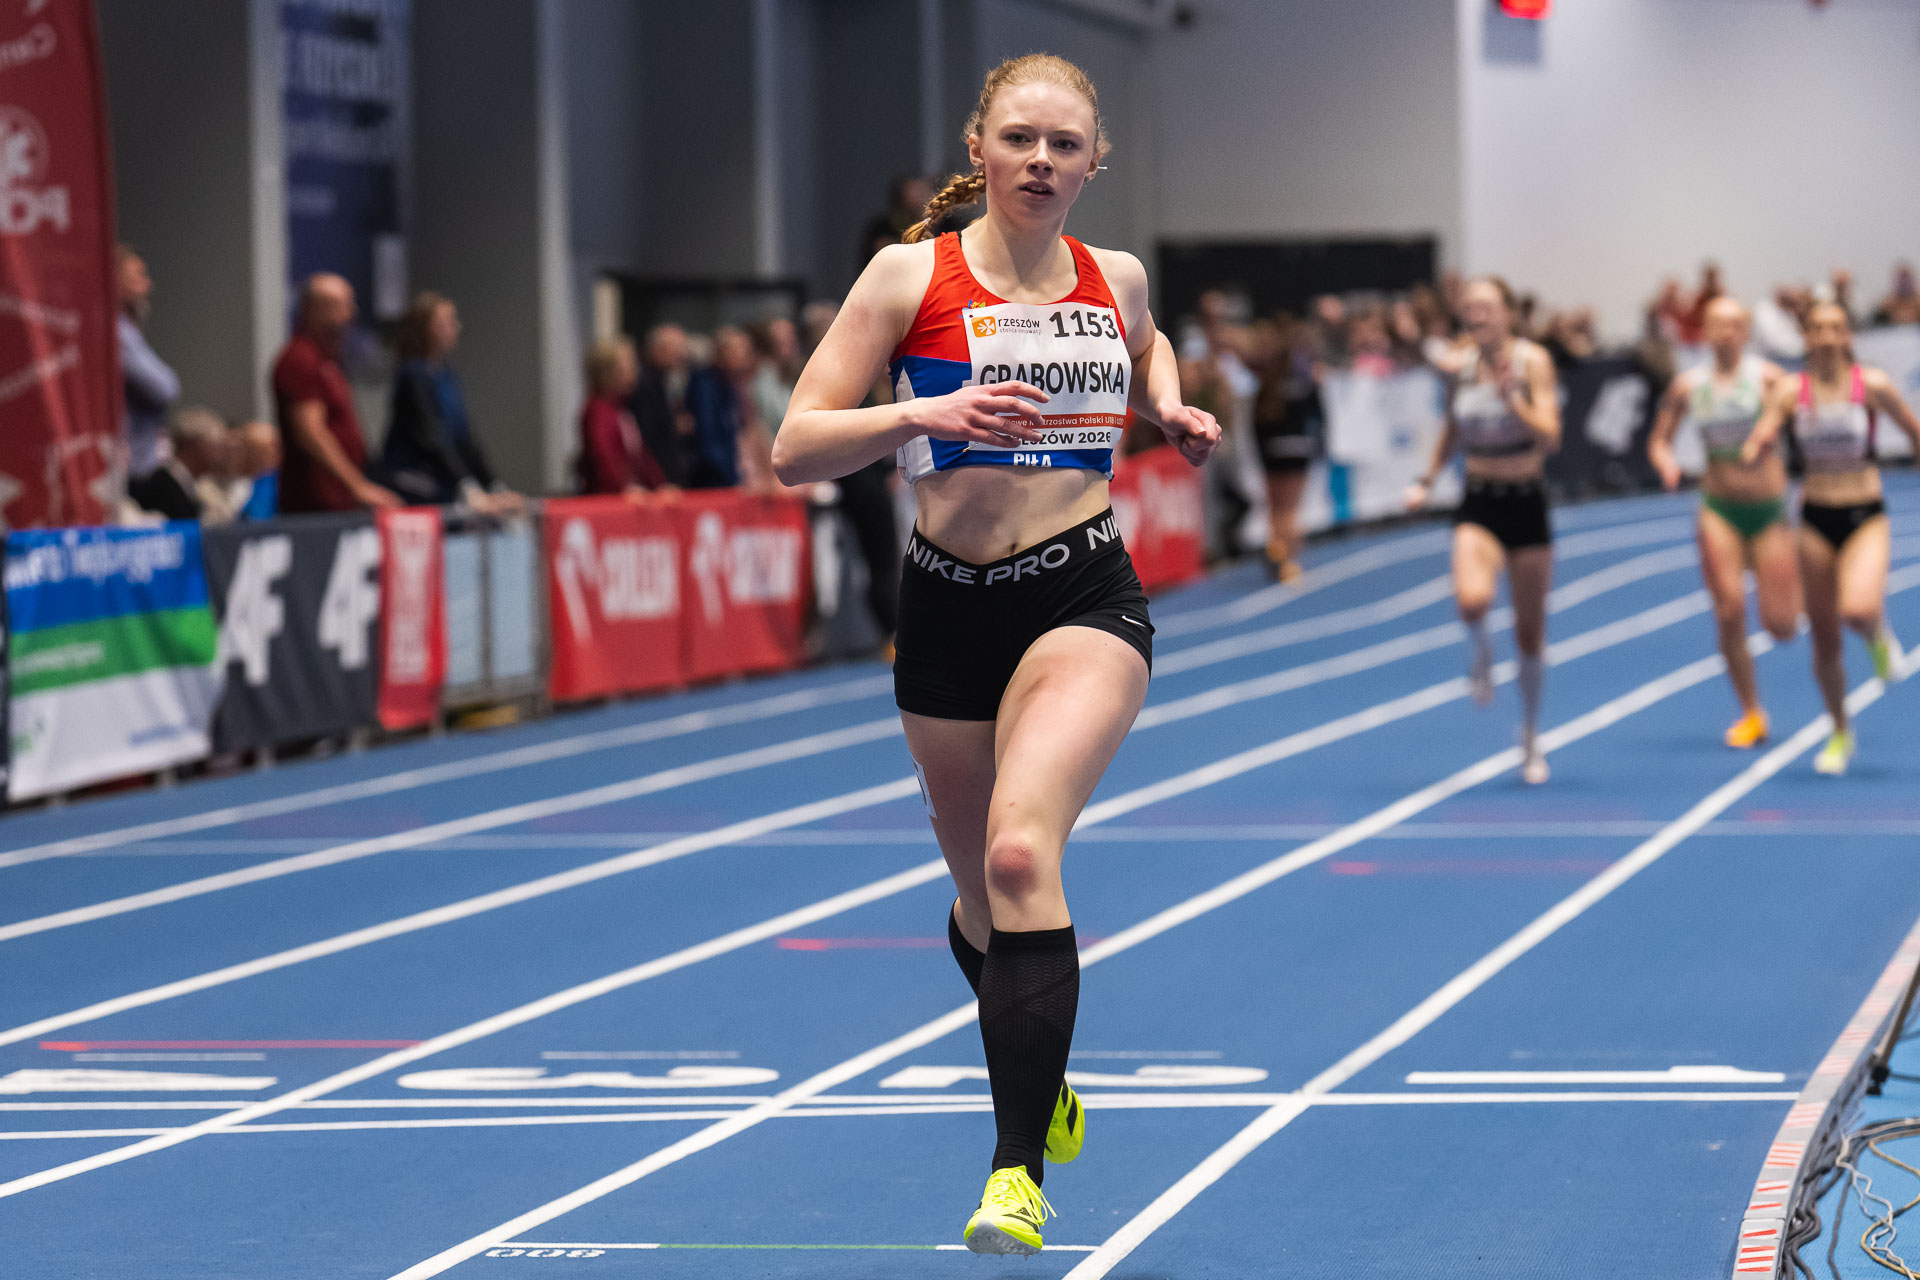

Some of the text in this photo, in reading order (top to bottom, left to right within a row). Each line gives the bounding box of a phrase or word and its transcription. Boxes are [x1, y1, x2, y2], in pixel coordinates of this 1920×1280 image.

[998, 318, 1040, 328] rzeszów
[1049, 310, 1119, 340] 1153
[1079, 416, 1104, 425] Polski
[1078, 431, 1111, 444] 2026
[1013, 452, 1052, 467] PIŁA
[907, 536, 977, 585] NIKE
[985, 543, 1070, 586] PRO
